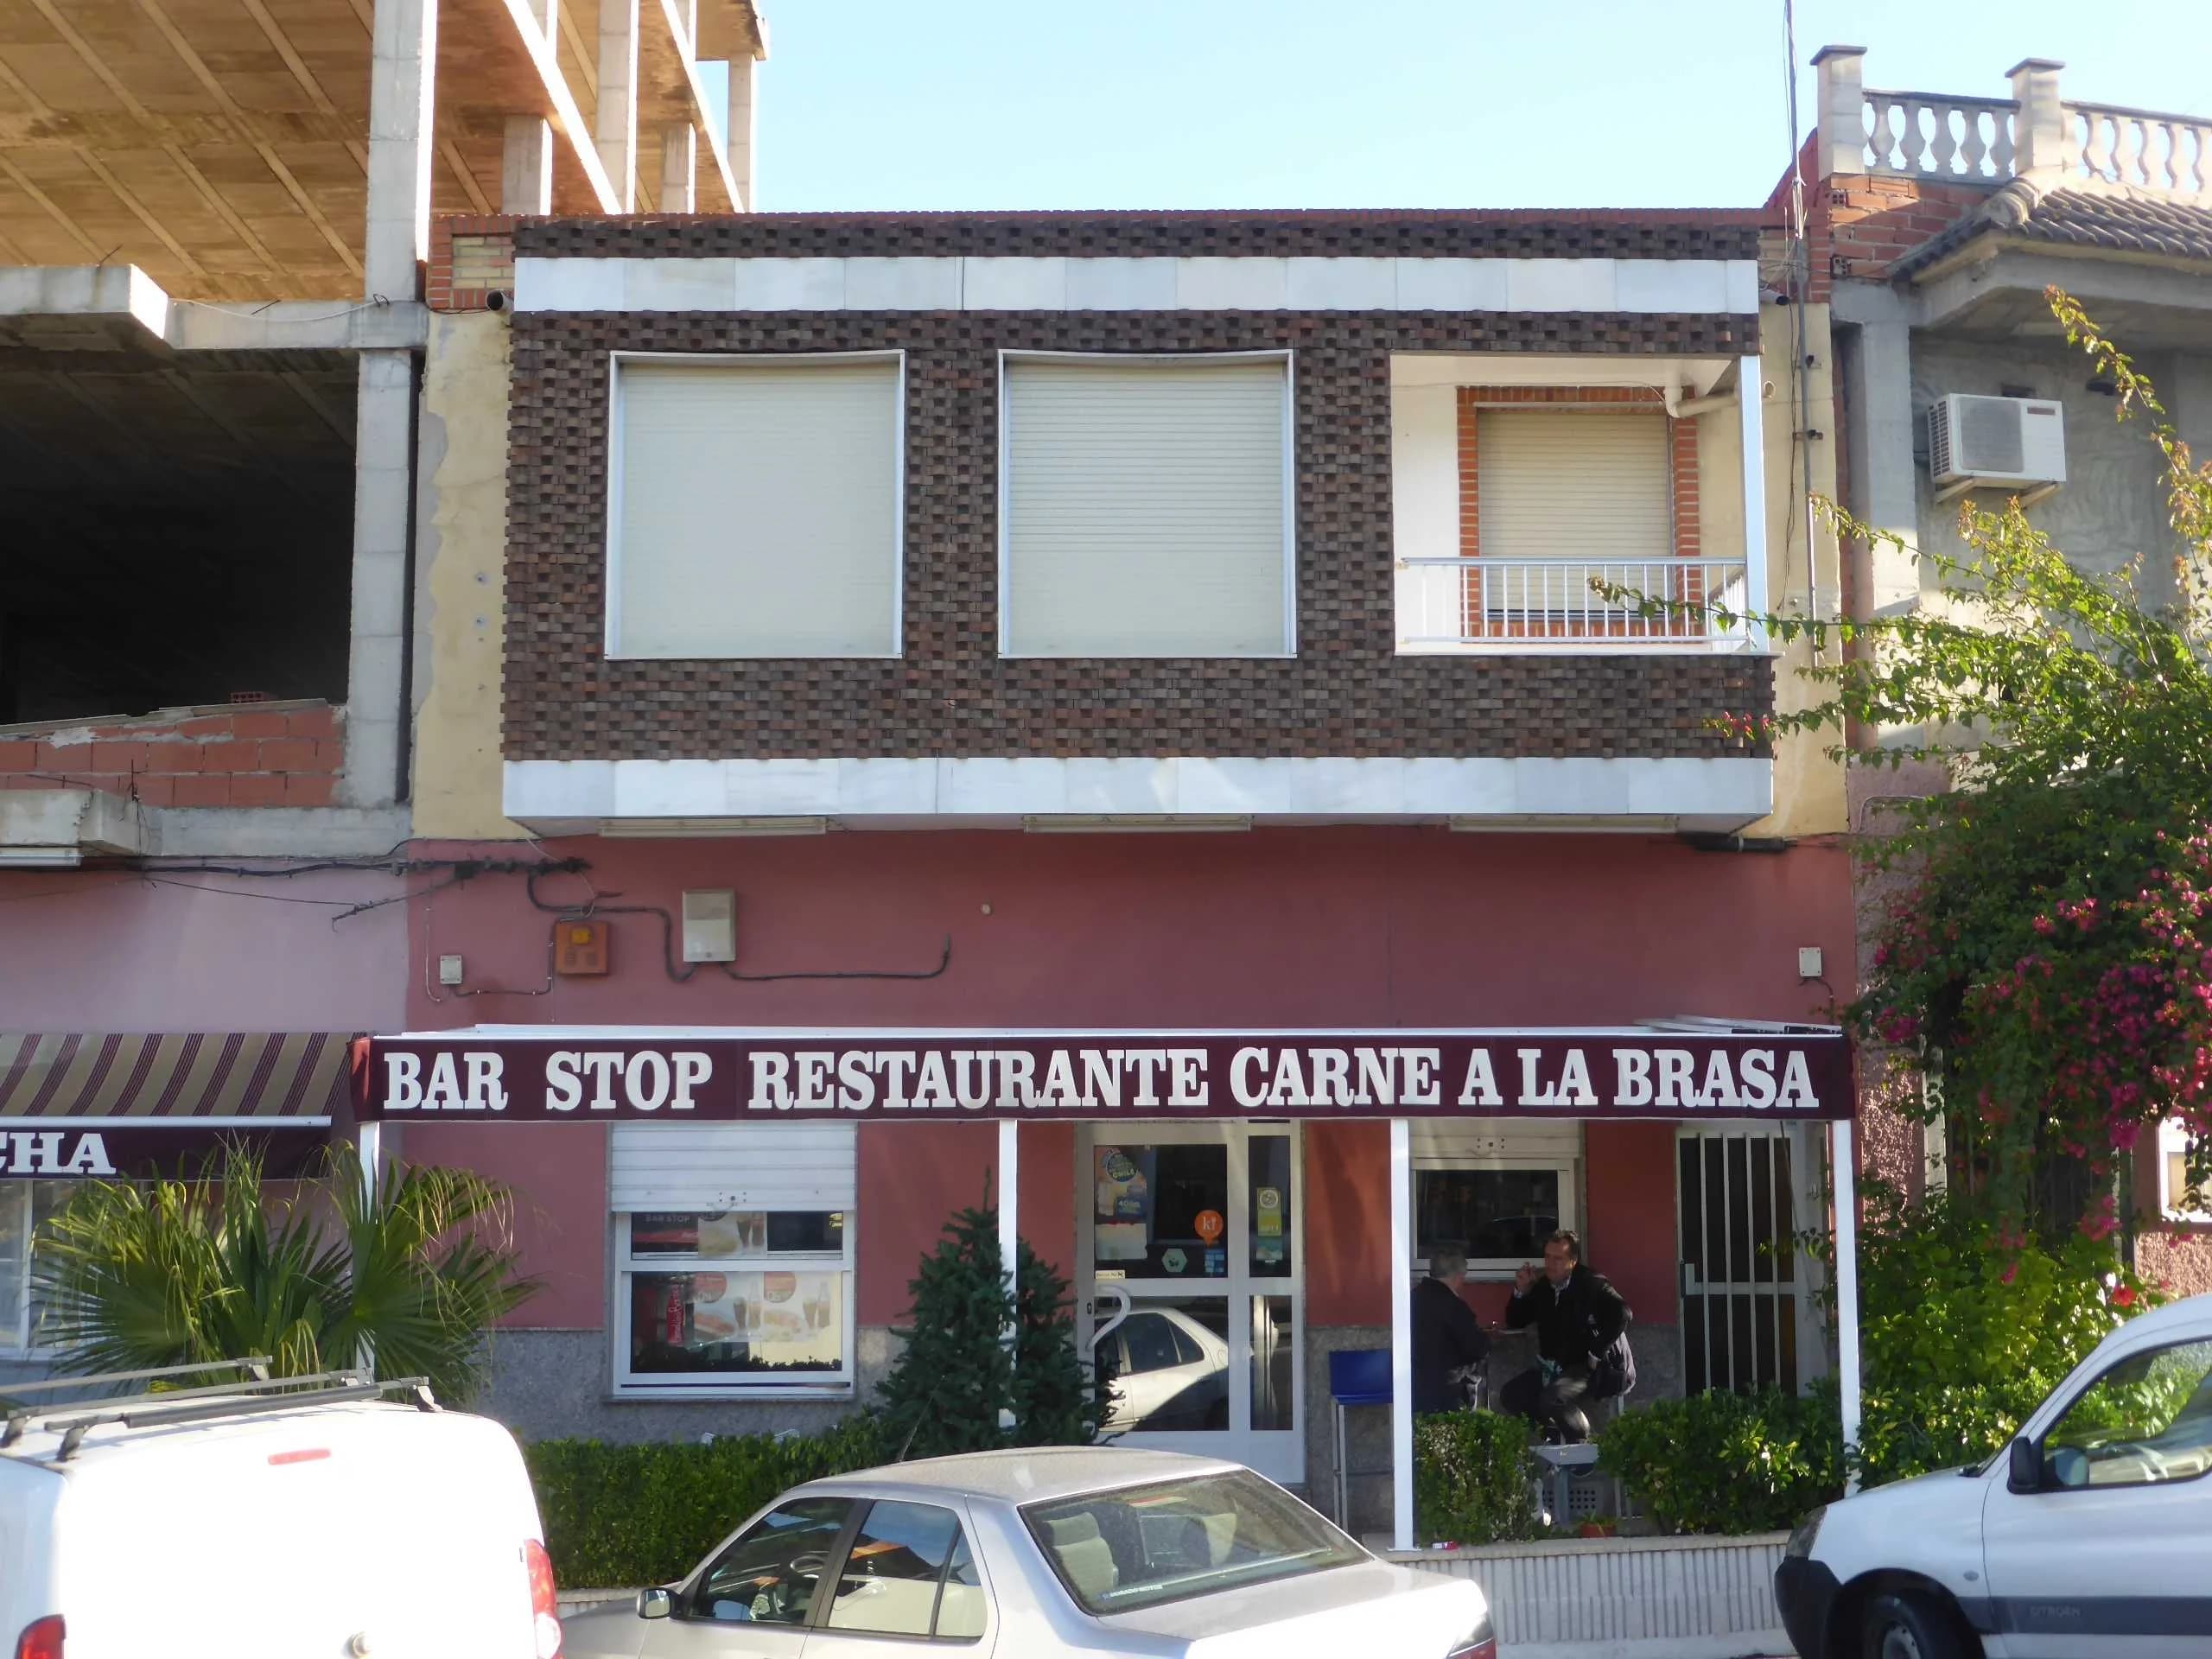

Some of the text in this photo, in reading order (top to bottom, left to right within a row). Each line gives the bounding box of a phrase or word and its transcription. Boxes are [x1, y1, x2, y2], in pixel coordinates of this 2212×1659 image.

[384, 1047, 1819, 1110] BAR STOP RESTAURANTE CARNE A LA BRASA
[0, 1131, 117, 1174] HA
